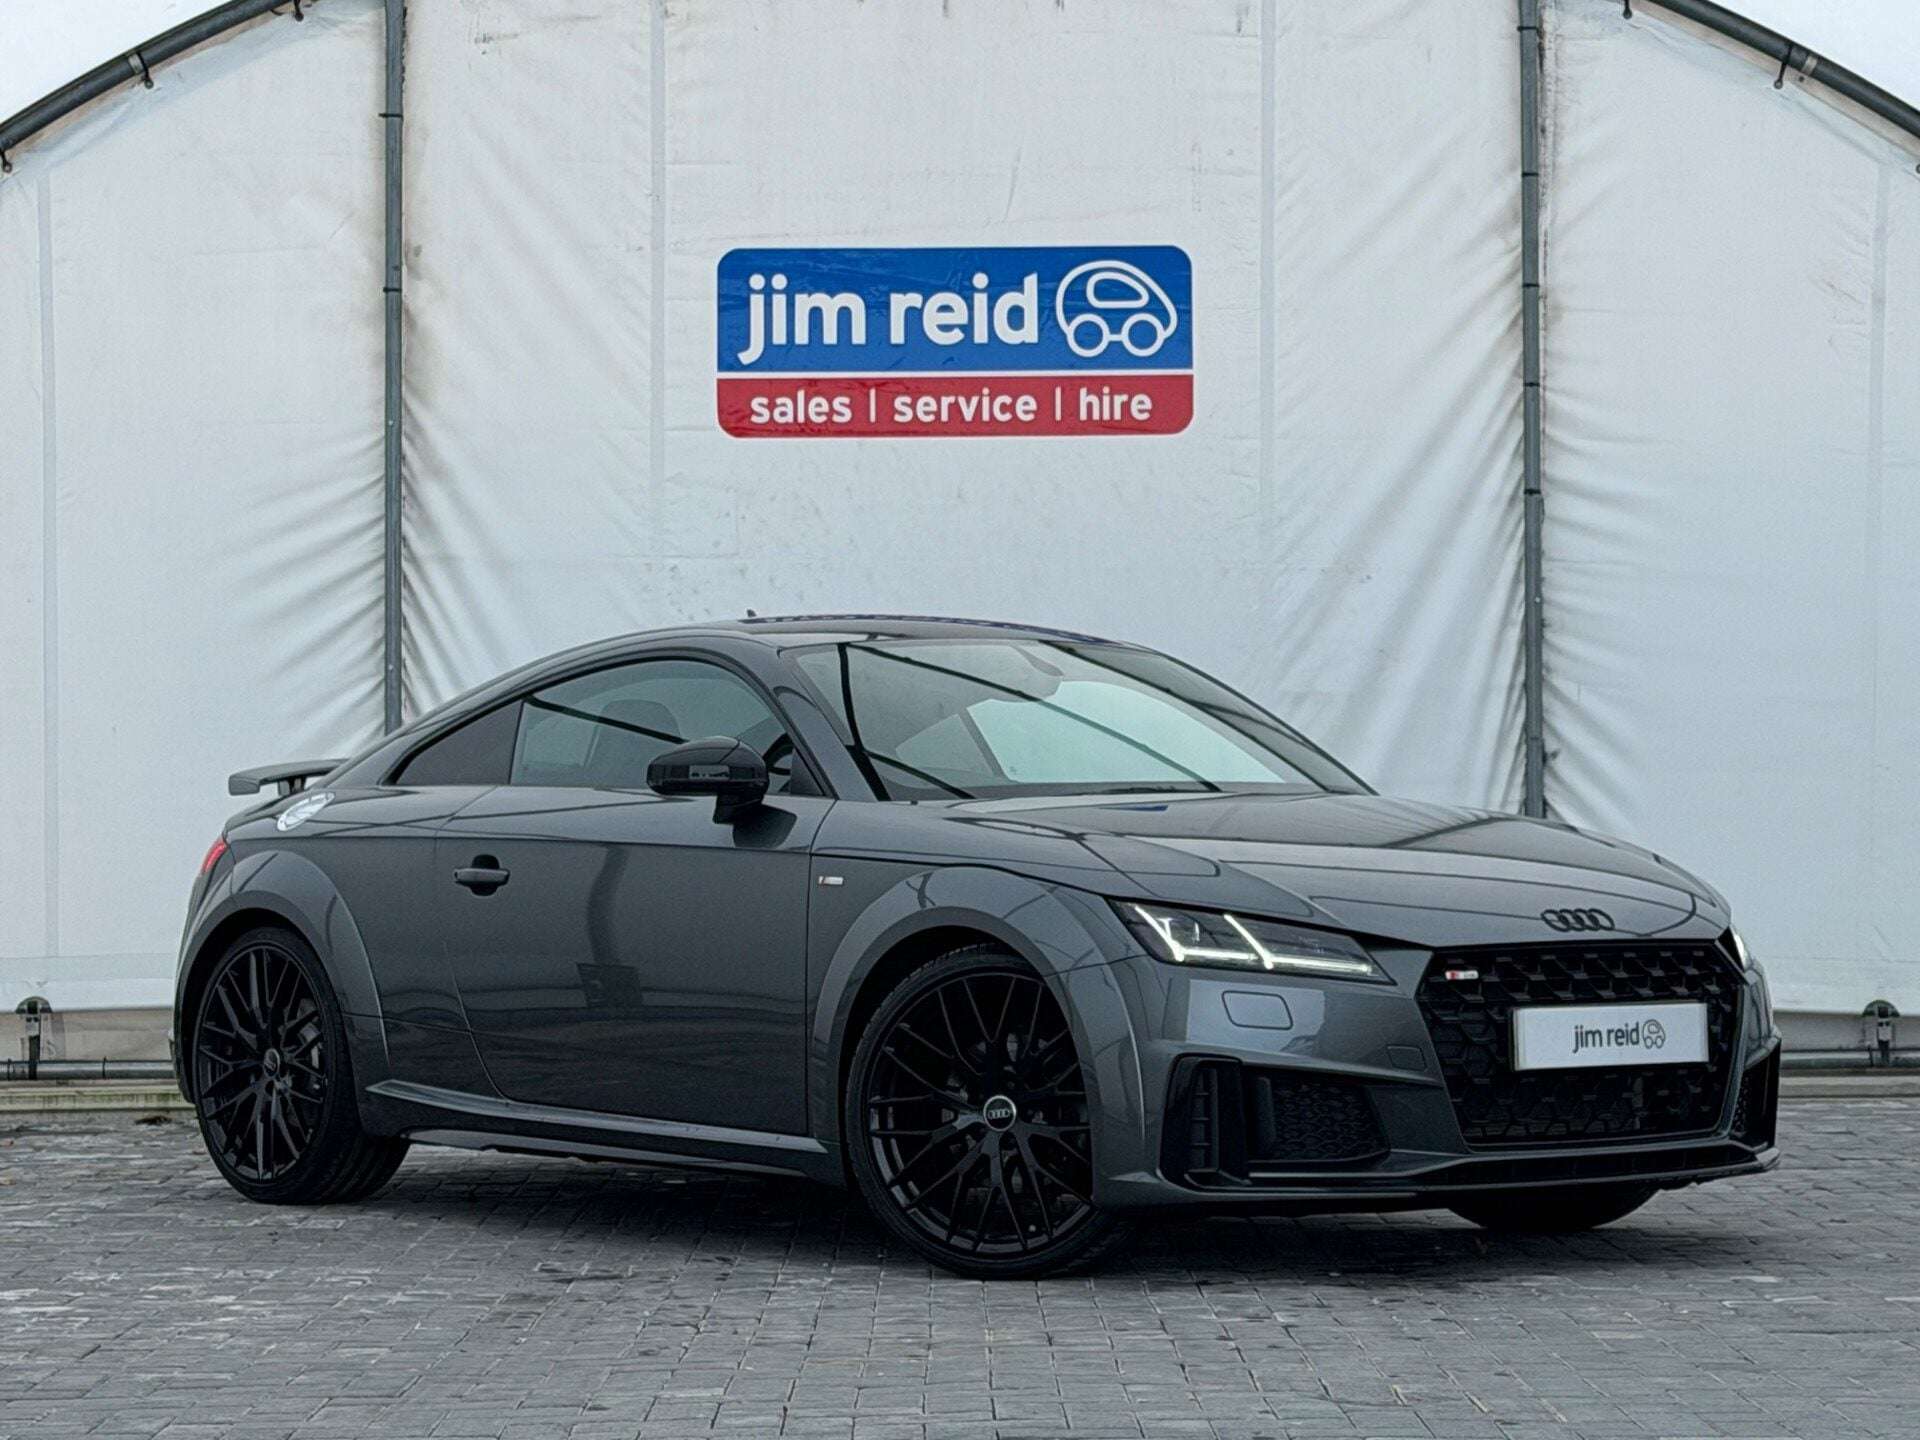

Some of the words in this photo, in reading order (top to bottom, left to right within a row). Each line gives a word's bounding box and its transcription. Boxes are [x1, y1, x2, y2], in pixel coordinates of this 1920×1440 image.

[737, 273, 866, 365] jim
[889, 272, 1039, 345] reid
[750, 389, 852, 424] sales
[893, 387, 1038, 423] service
[1079, 387, 1153, 421] hire
[1572, 1024, 1603, 1054] jim
[1606, 1021, 1641, 1048] reid
